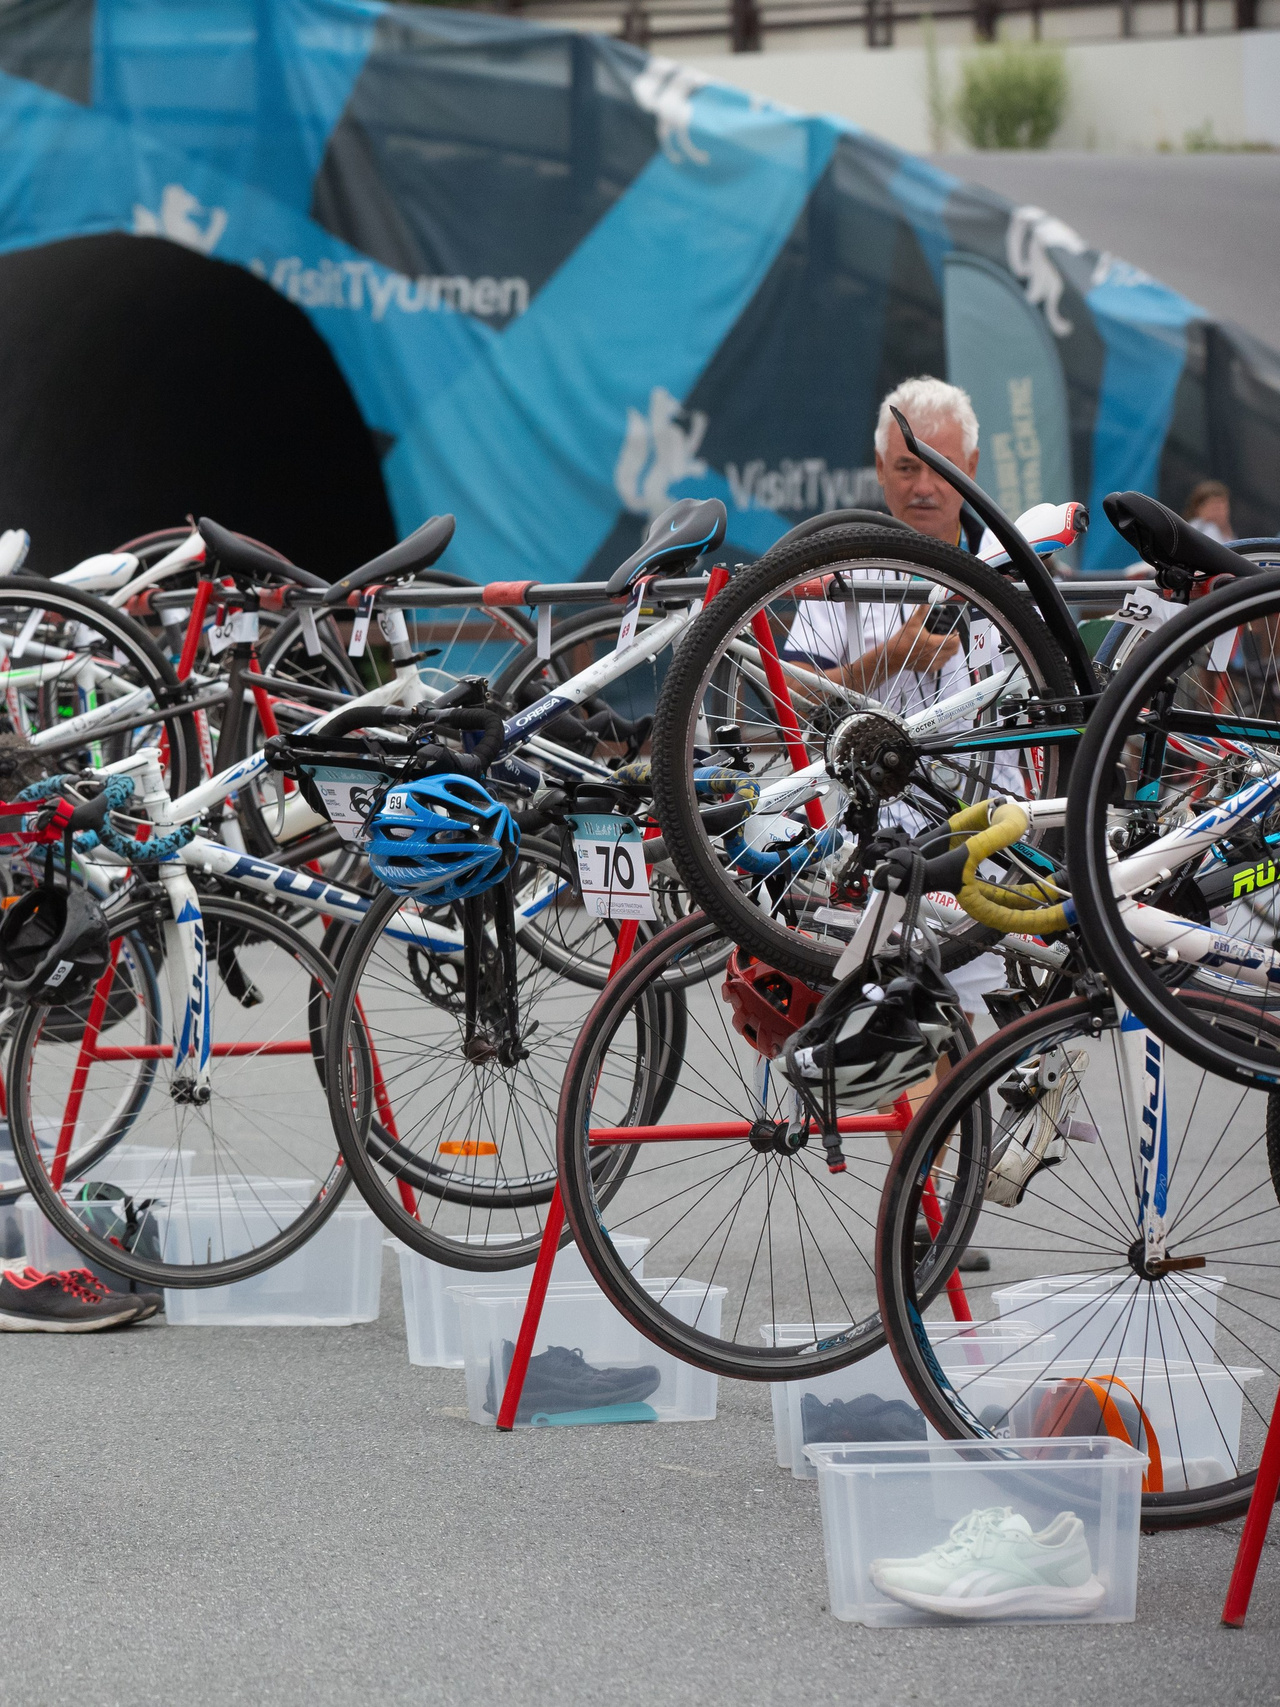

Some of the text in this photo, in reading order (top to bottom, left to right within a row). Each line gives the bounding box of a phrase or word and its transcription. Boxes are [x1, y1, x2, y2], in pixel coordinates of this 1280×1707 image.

[1118, 602, 1153, 621] 53
[515, 697, 561, 727] ORBEA
[389, 796, 402, 810] 69
[595, 845, 635, 890] 70
[1232, 858, 1280, 899] RU
[225, 856, 375, 915] FUJ
[51, 966, 67, 981] 68
